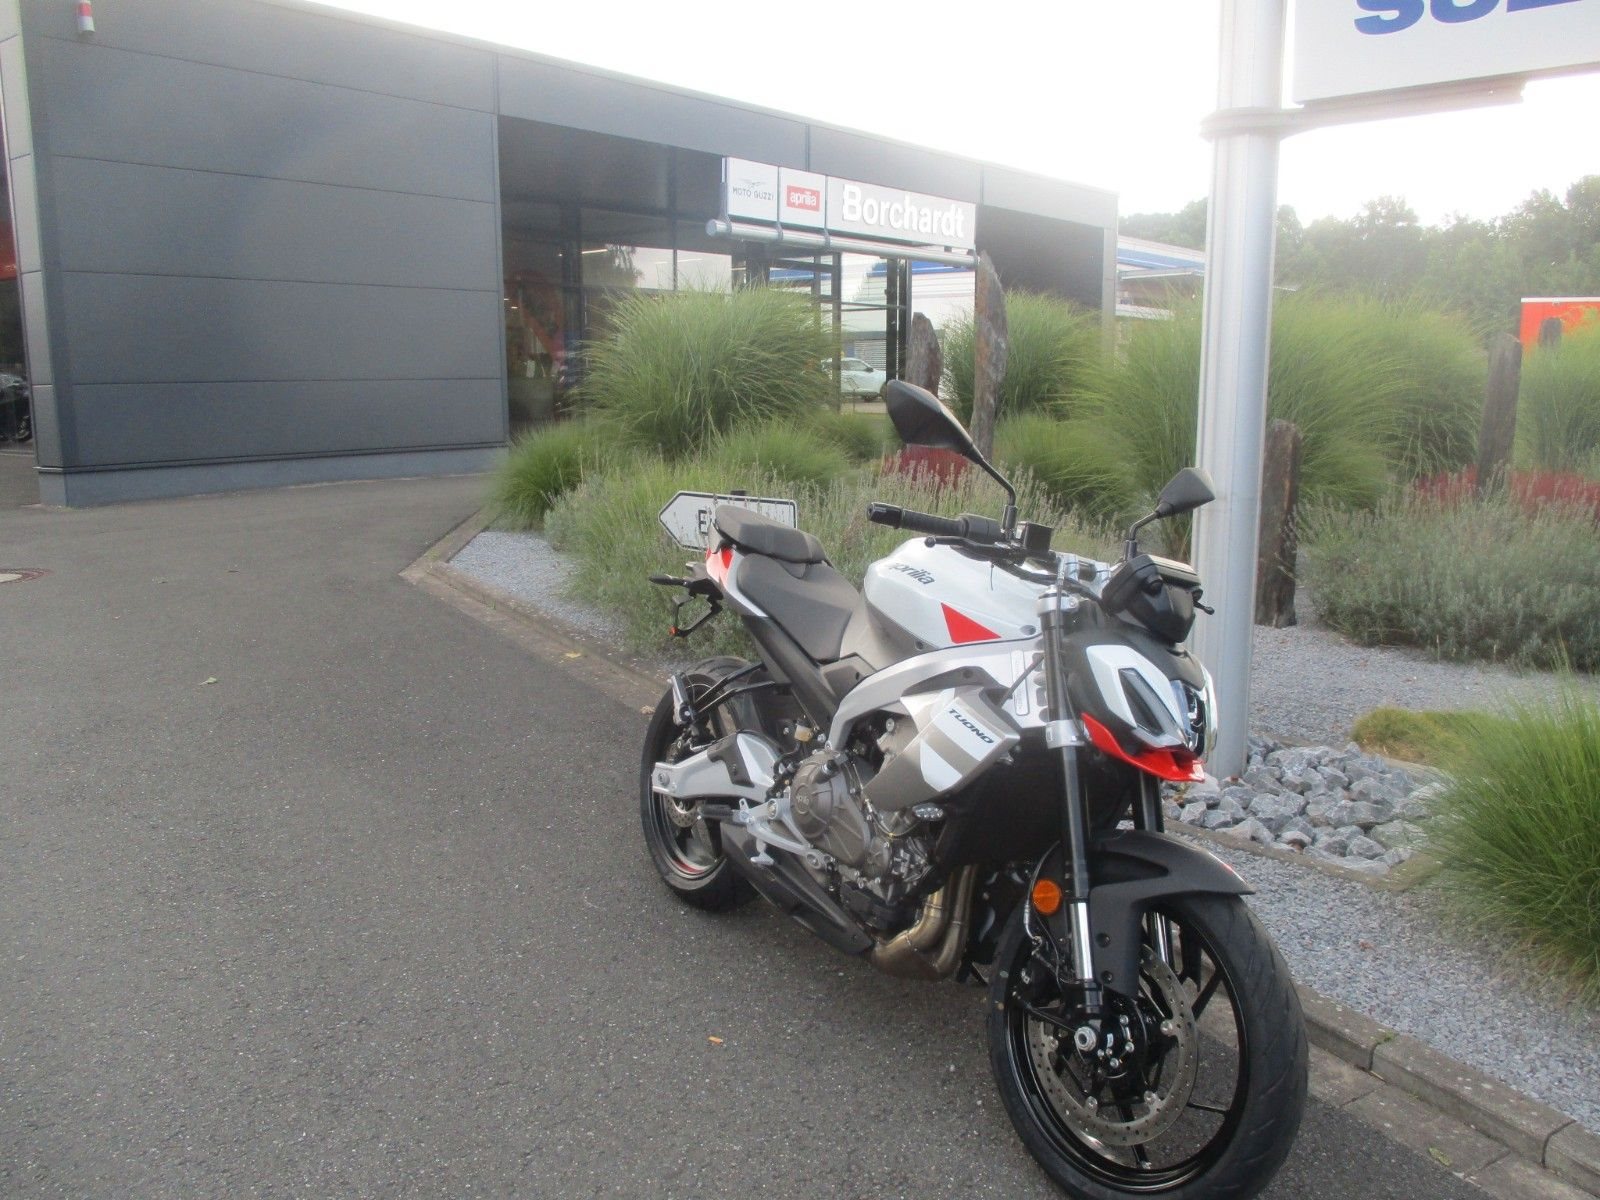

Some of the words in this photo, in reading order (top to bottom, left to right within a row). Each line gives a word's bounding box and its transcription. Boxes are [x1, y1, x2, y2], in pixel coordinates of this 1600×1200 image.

[732, 186, 752, 198] MOTO
[754, 190, 774, 201] GUZZI
[790, 191, 817, 206] aprilia
[842, 184, 965, 238] Borchardt
[948, 707, 995, 744] TUONO
